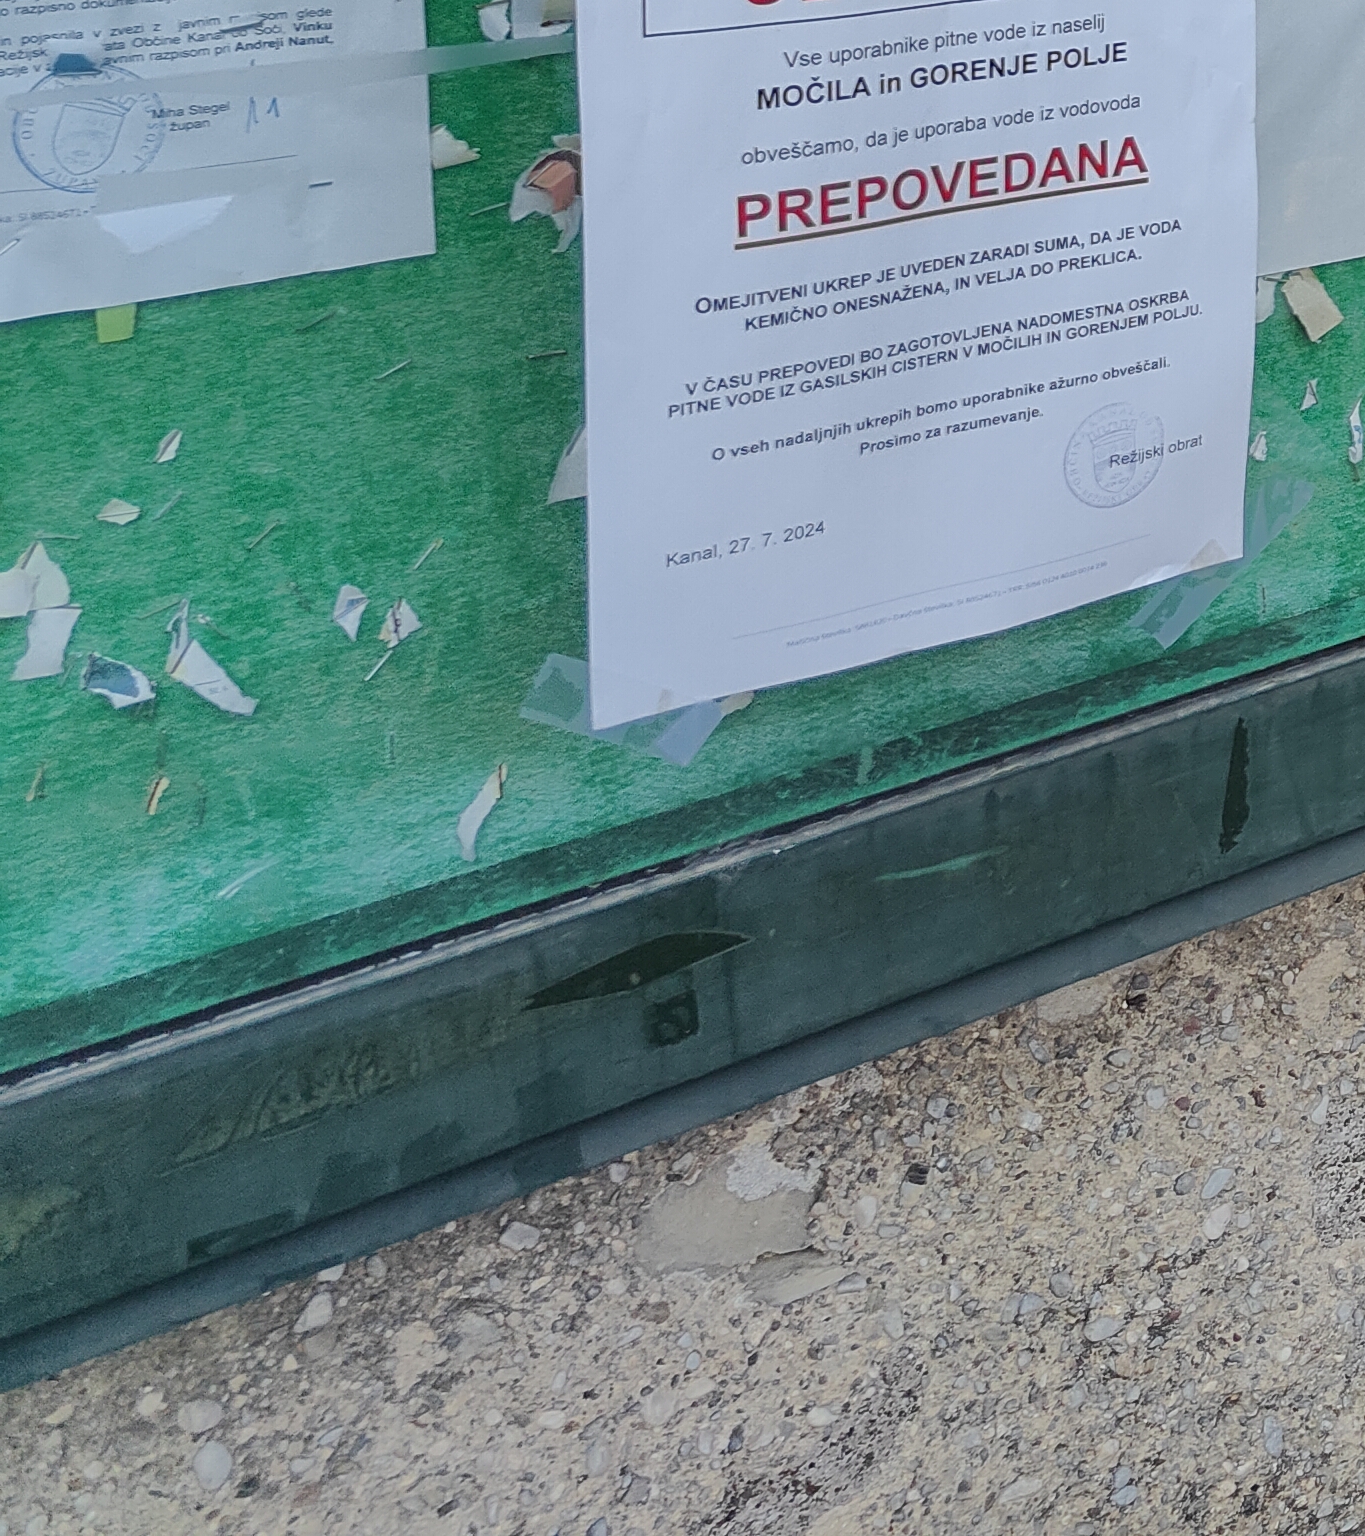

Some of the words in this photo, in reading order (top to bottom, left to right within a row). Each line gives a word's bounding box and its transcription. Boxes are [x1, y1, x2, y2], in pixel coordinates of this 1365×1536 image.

[758, 76, 870, 110] MOČILA
[881, 73, 900, 95] in
[911, 53, 1037, 88] GORENJE
[1048, 41, 1127, 72] POLJE
[784, 50, 822, 68] Vse
[830, 36, 928, 66] uporabnike
[935, 31, 977, 52] pitne
[984, 23, 1026, 42] vode
[1032, 24, 1046, 37] iz
[1053, 13, 1104, 35] naselij
[741, 139, 858, 165] obveščamo,
[866, 130, 887, 148] da
[892, 129, 908, 148] je
[915, 116, 986, 142] uporaba
[993, 109, 1034, 127] vode
[1041, 108, 1054, 121] iz
[1060, 94, 1140, 118] vodovoda
[738, 136, 1148, 238] PREPOVEDANA
[746, 304, 827, 331] KEMIČNO
[833, 281, 949, 315] ONESNAŽENA,
[956, 276, 970, 291] IN
[975, 267, 1026, 286] VELJA
[1031, 262, 1053, 277] DO
[1059, 248, 1141, 273] PREKLICA.
[814, 272, 871, 295] UKREP
[876, 267, 895, 283] JE
[901, 254, 965, 278] UVEDEN
[970, 243, 1028, 265] ZARADI
[1035, 235, 1084, 254] SUMA,
[1091, 231, 1112, 245] DA
[1117, 226, 1134, 241] JE
[1139, 219, 1181, 237] VODA
[686, 383, 697, 396] V
[704, 373, 752, 392] ČASU
[759, 353, 854, 384] PREPOVEDI
[861, 347, 883, 363] BO
[887, 321, 1013, 358] ZAGOTOVLJENA
[1018, 301, 1124, 331] NADOMESTNA
[1129, 289, 1189, 311] OSKRBA
[712, 447, 725, 461] O
[731, 439, 769, 457] vseh
[776, 423, 851, 448] nadaljnjih
[857, 409, 911, 431] ukrepih
[917, 400, 957, 417] bomo
[963, 382, 1044, 408] uporabnike
[1050, 373, 1097, 390] ažurno
[1103, 357, 1170, 380] obveščali.
[860, 432, 921, 455] Prosimo
[926, 428, 940, 439] za
[947, 407, 1042, 435] razumevanje.
[1110, 443, 1164, 468] Režijski
[1169, 434, 1202, 454] obrat
[667, 544, 722, 568] Kanal,
[730, 537, 755, 555] 27.
[763, 532, 776, 547] 7.
[784, 521, 824, 543] 2024
